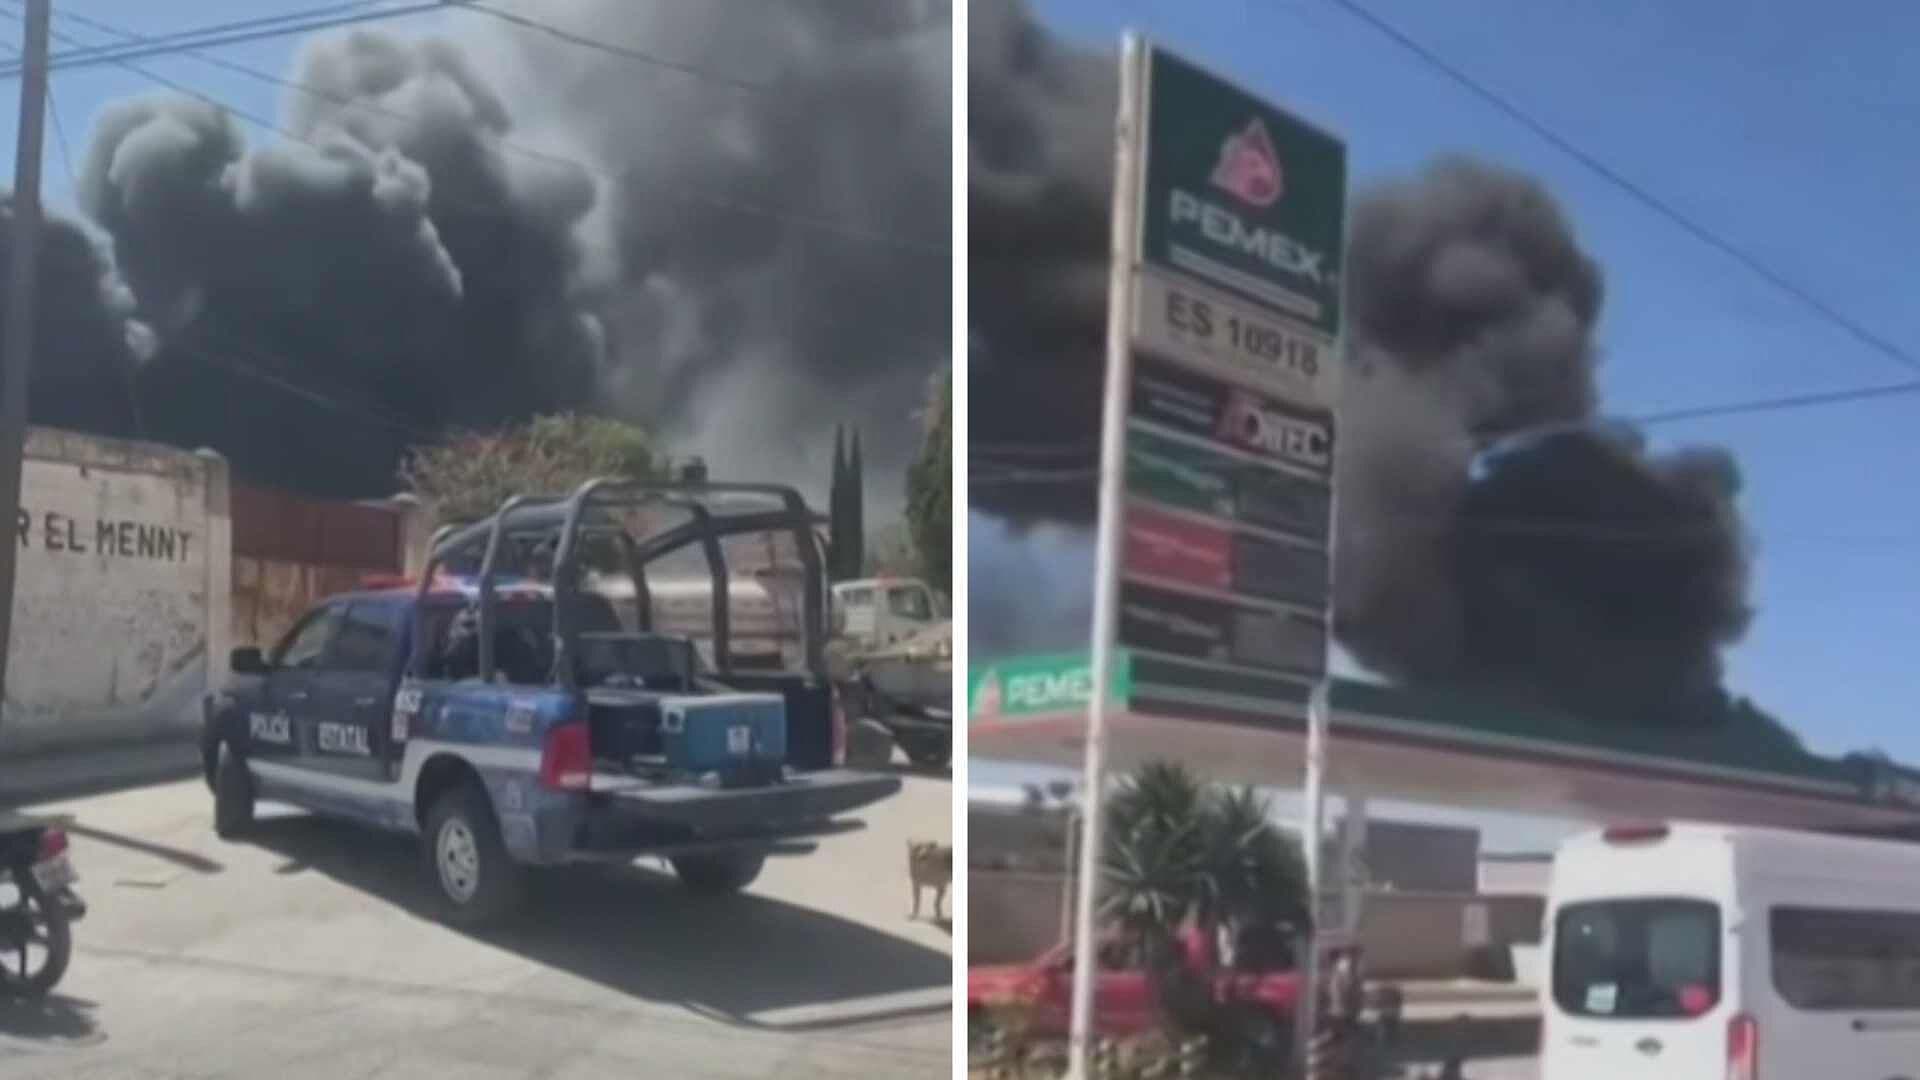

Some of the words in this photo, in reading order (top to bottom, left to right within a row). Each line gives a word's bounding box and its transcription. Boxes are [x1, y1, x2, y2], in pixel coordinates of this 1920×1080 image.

[1168, 188, 1324, 285] PEMEX
[1164, 290, 1214, 340] ES
[44, 511, 86, 554] EL
[95, 518, 193, 563] MENNY
[1007, 666, 1093, 709] PEME
